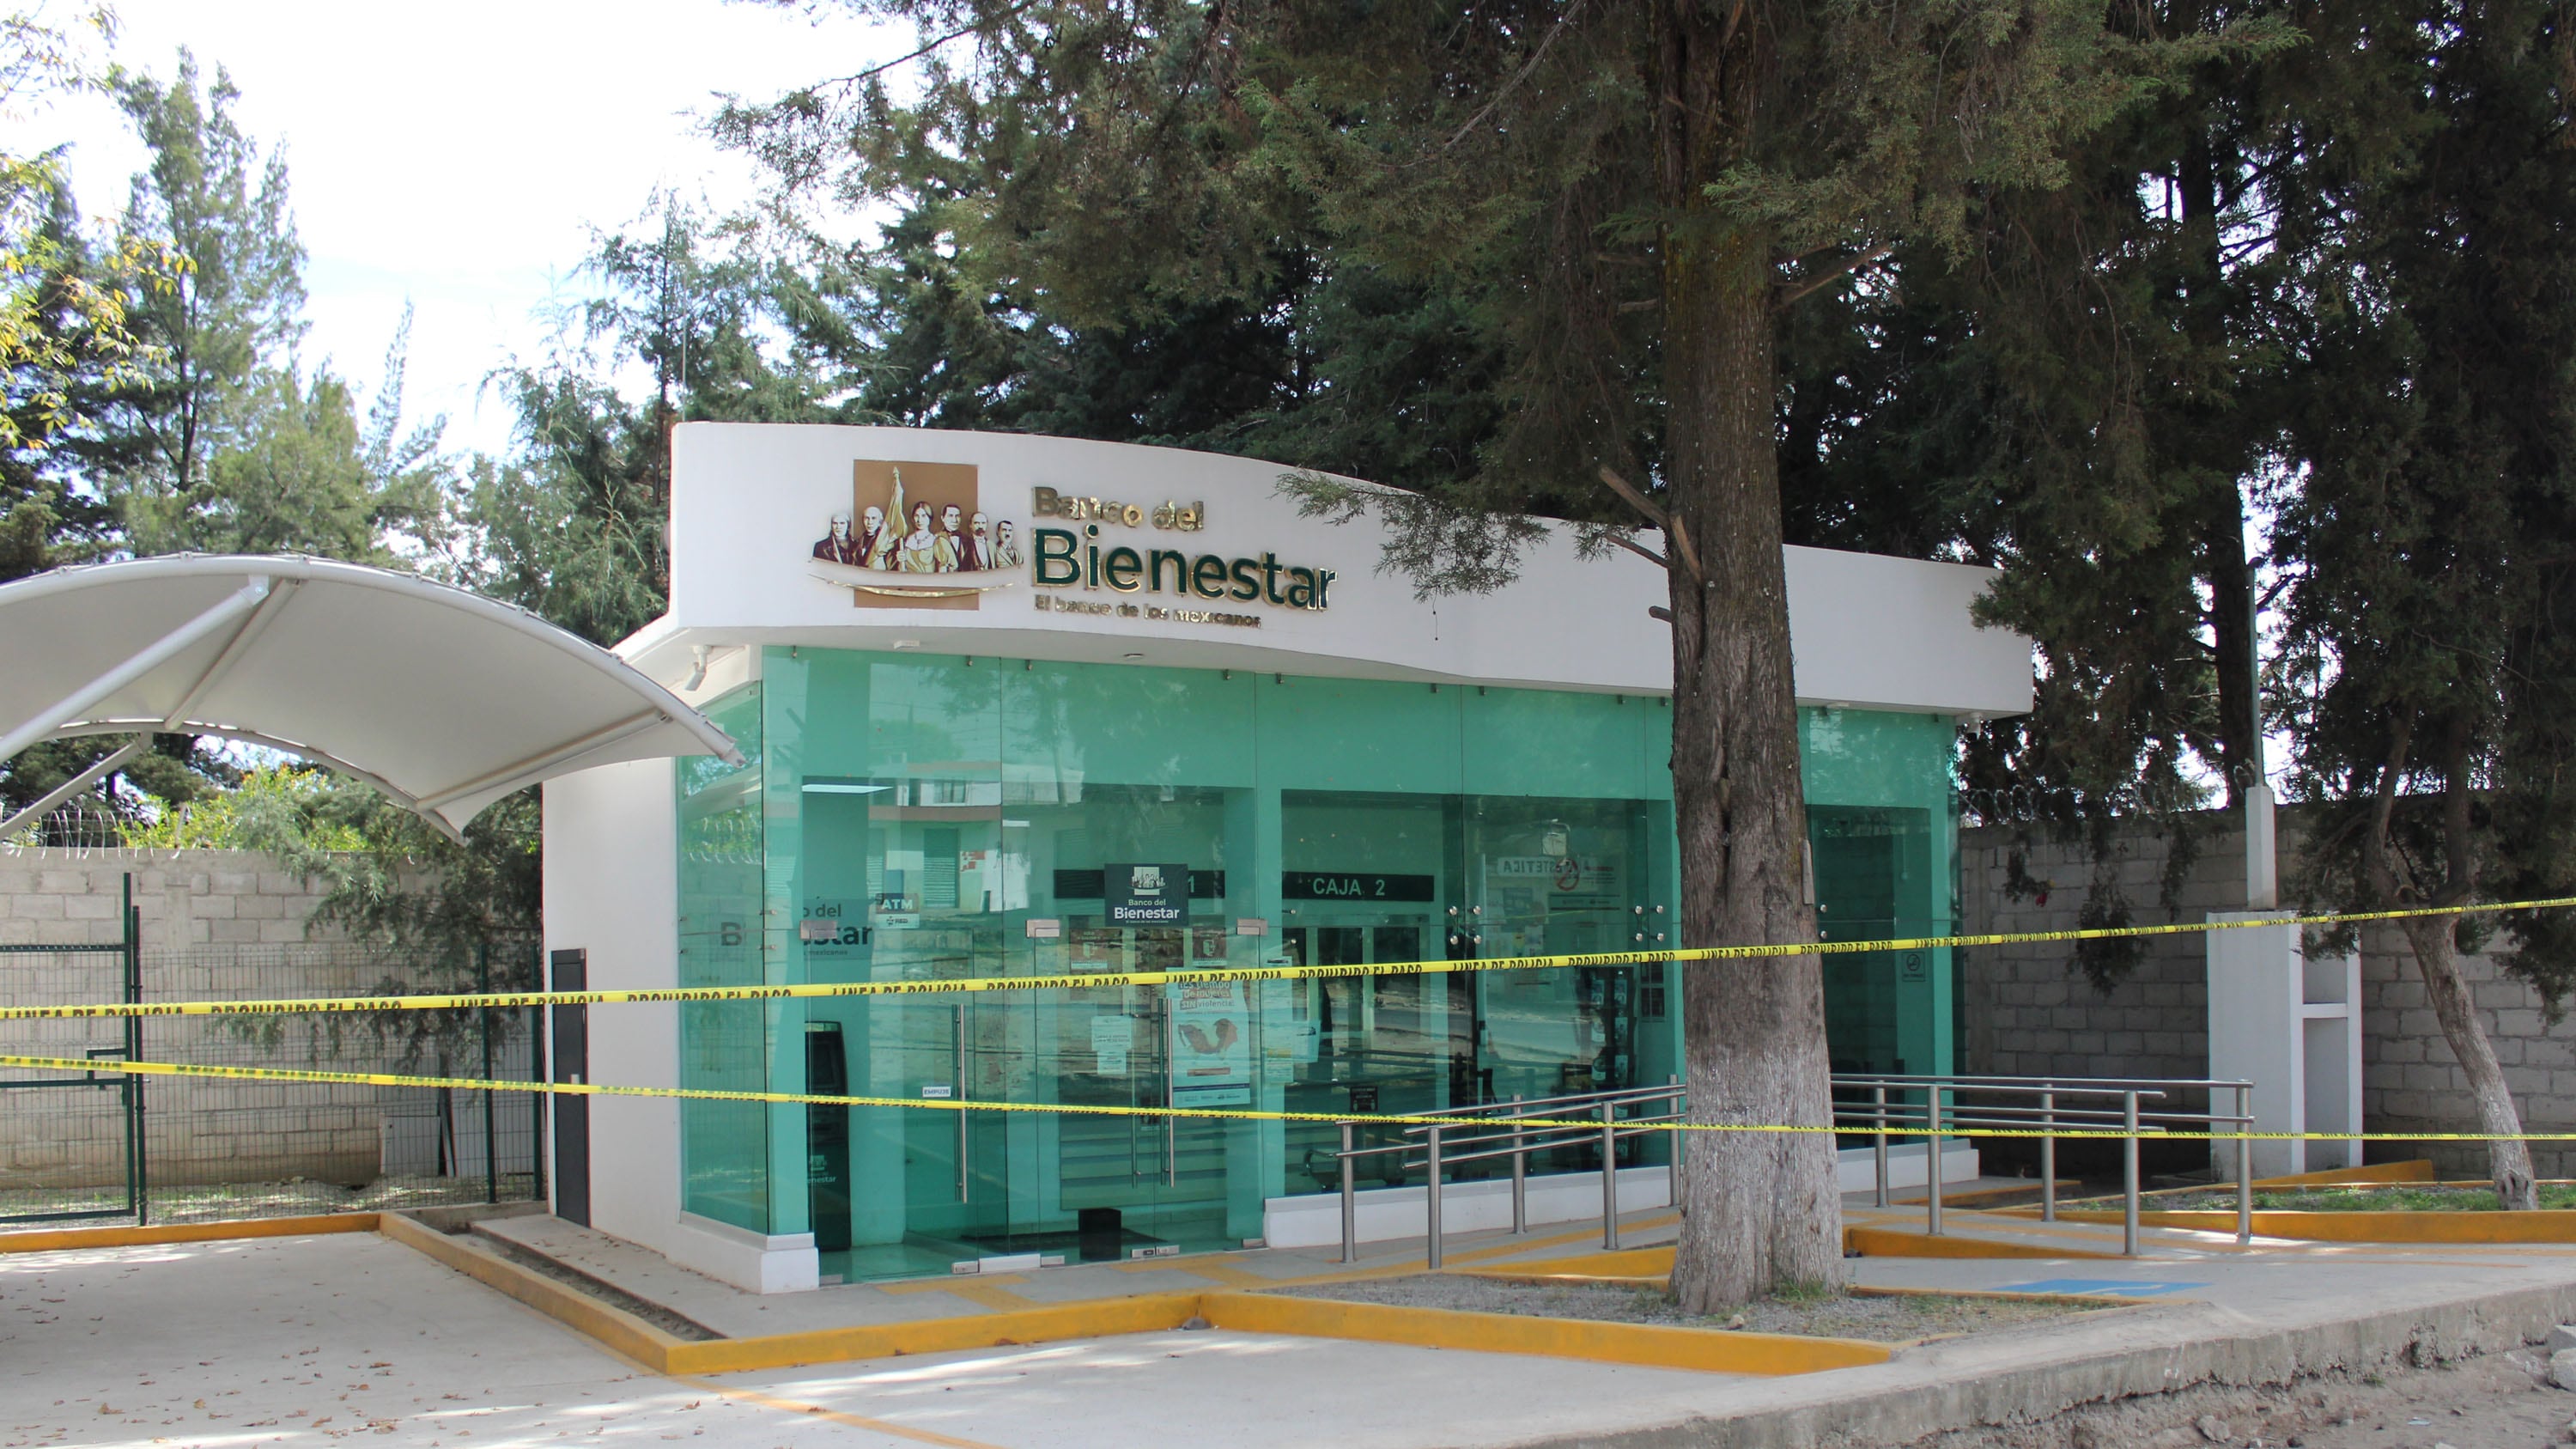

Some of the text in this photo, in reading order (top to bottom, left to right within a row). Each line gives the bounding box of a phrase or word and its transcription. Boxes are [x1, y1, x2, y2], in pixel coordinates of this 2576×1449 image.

[1032, 486, 1204, 532] Banco del
[1031, 523, 1338, 612] Bienestar
[1035, 594, 1261, 629] El banco de los mexicanos
[1313, 878, 1385, 896] CAJA 2
[816, 904, 841, 917] del
[881, 898, 913, 910] ATM
[1115, 907, 1180, 919] Bienestar
[1181, 1001, 1197, 1009] SIN
